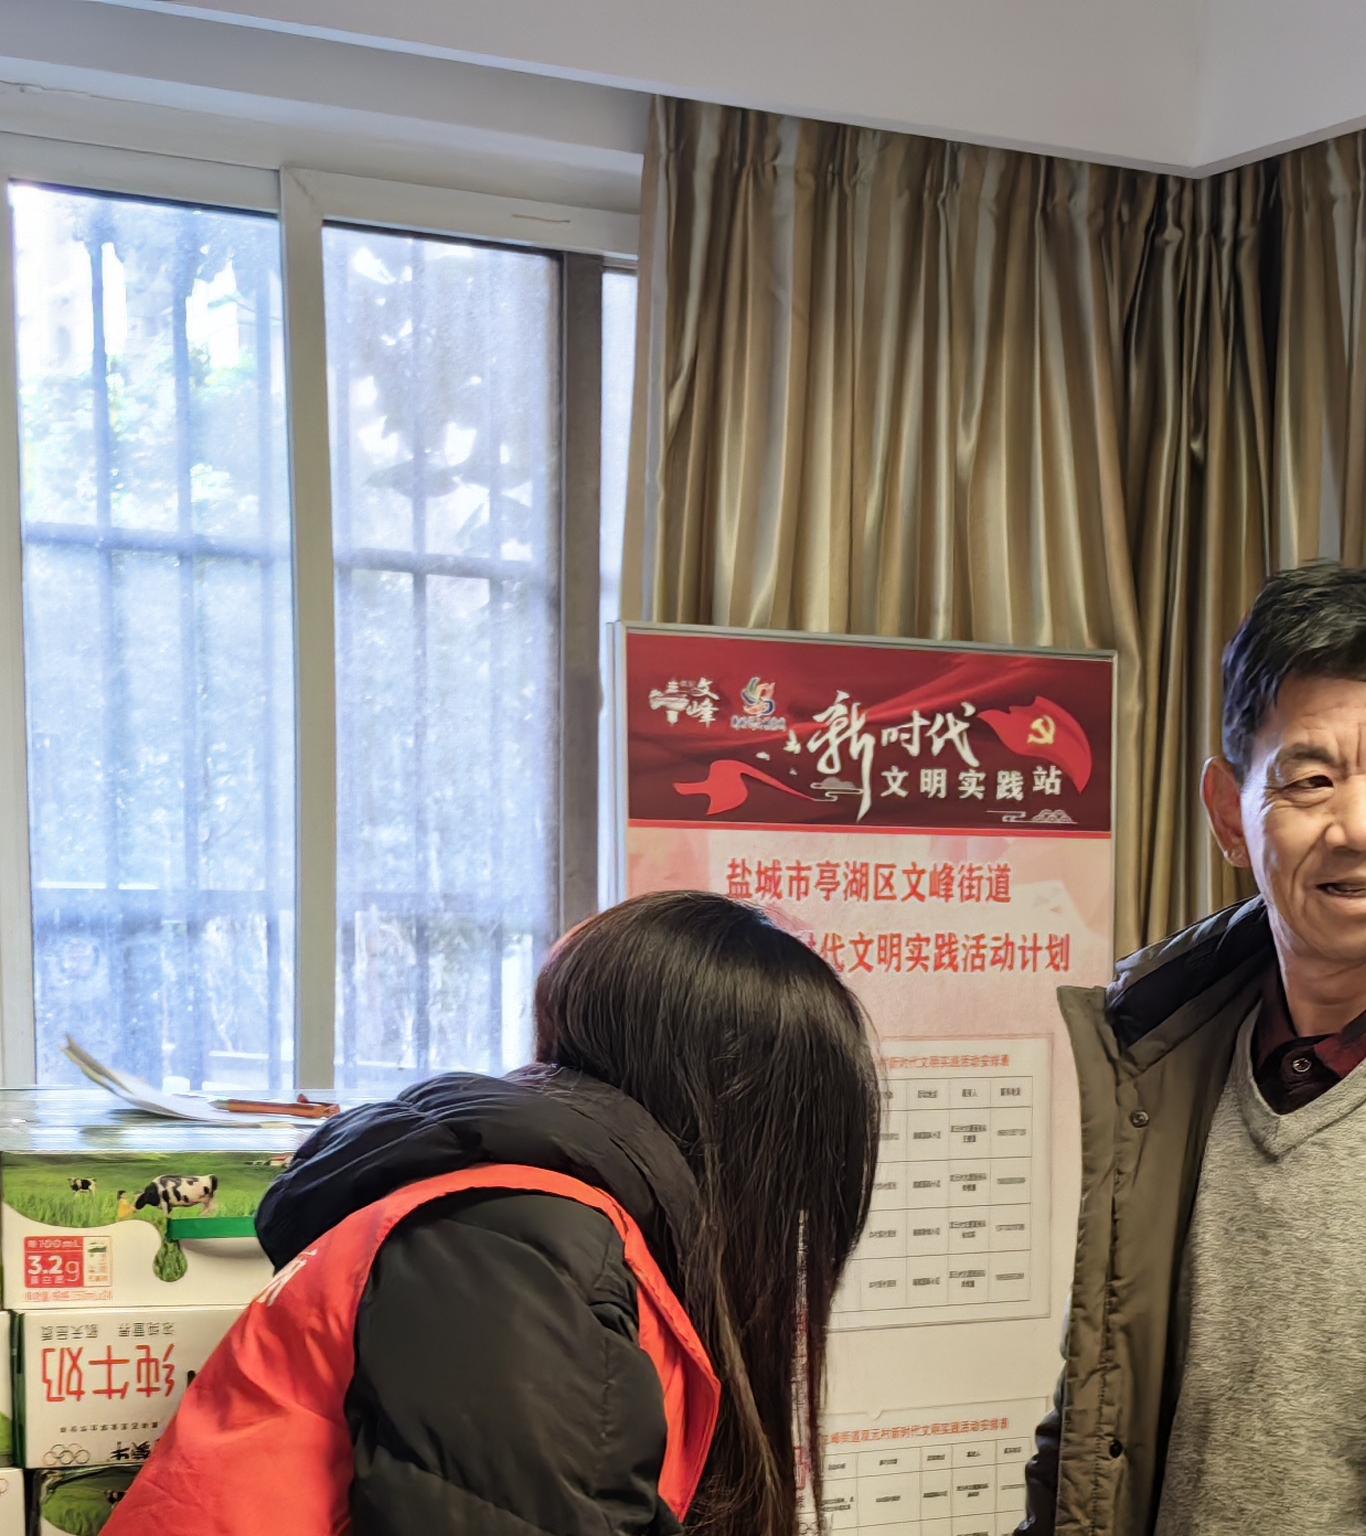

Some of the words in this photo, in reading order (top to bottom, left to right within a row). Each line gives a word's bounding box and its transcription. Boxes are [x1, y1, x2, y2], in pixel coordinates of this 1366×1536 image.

[807, 690, 981, 823] 新时代
[880, 764, 1062, 802] 文明实践站
[726, 857, 1012, 904] 盐城市亭湖区文峰街道
[807, 932, 1071, 974] 代文明实践活动计划
[28, 1252, 80, 1281] 3.2g
[41, 1344, 176, 1403] 纯牛奶
